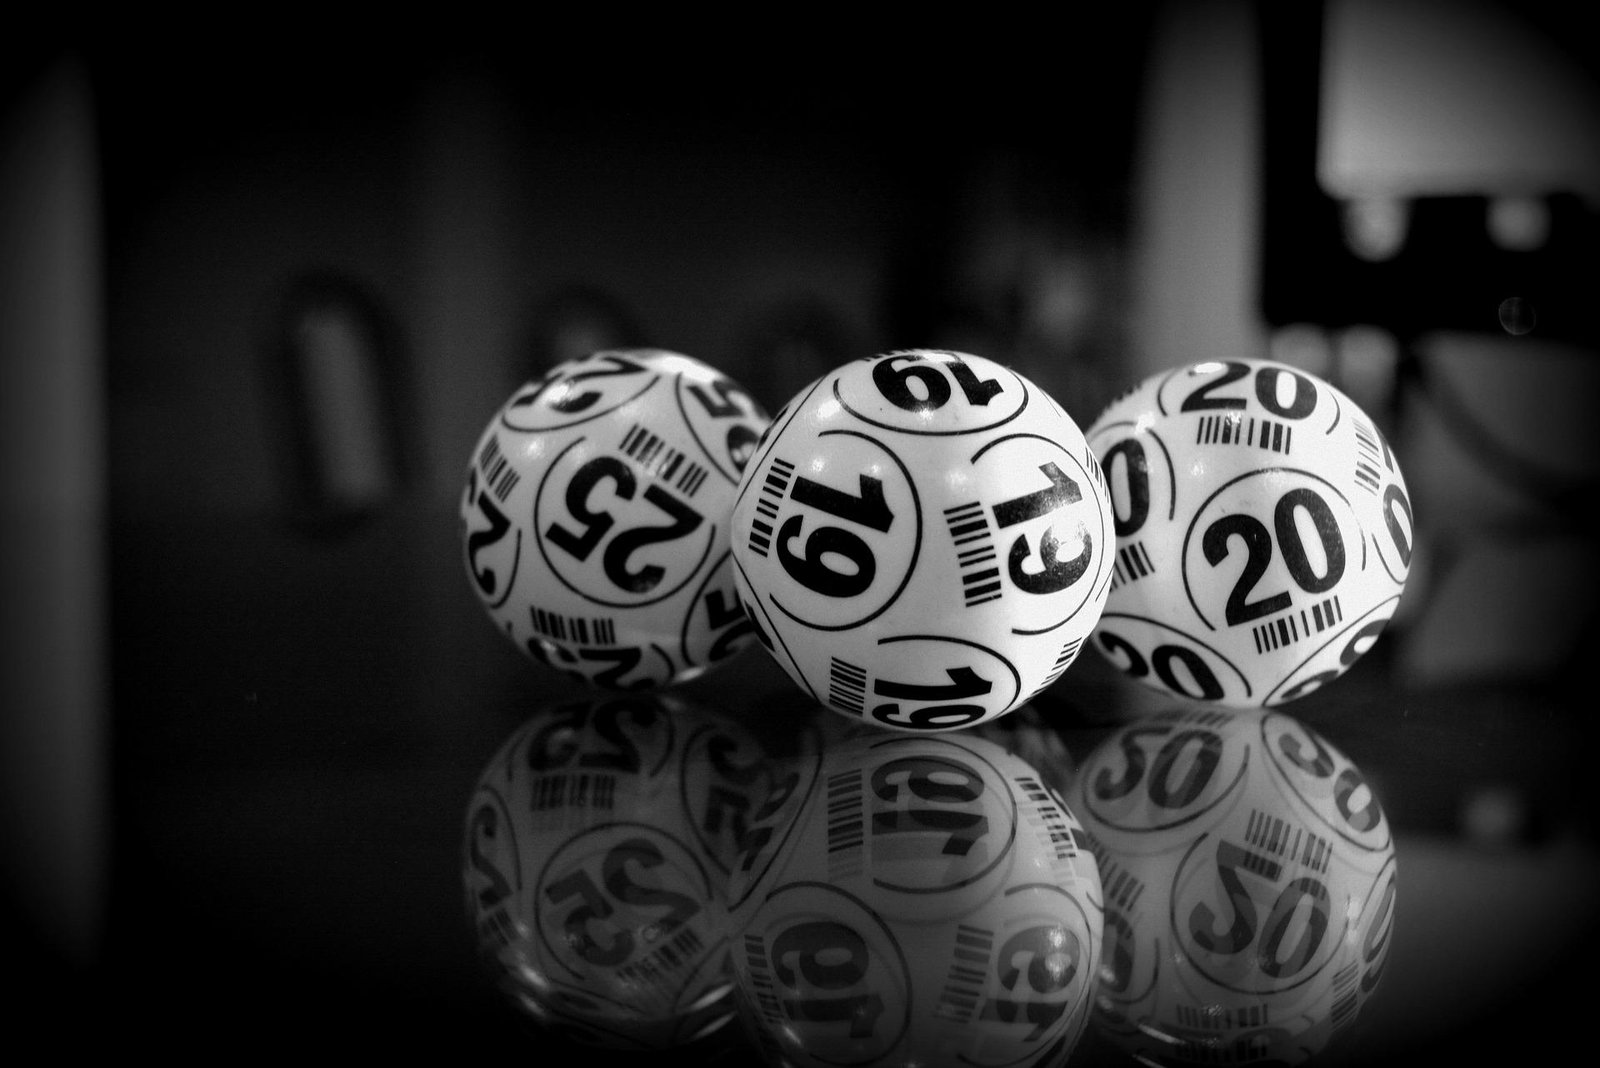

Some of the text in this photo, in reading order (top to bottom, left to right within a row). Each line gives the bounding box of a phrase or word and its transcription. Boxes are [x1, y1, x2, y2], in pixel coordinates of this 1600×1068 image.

[872, 354, 1005, 413] 19
[1181, 361, 1318, 421] 20
[545, 456, 705, 593] 25
[776, 473, 895, 598] 19
[992, 460, 1093, 595] 19
[1101, 437, 1150, 538] 0
[1202, 487, 1346, 628] 20
[871, 665, 993, 730] 19
